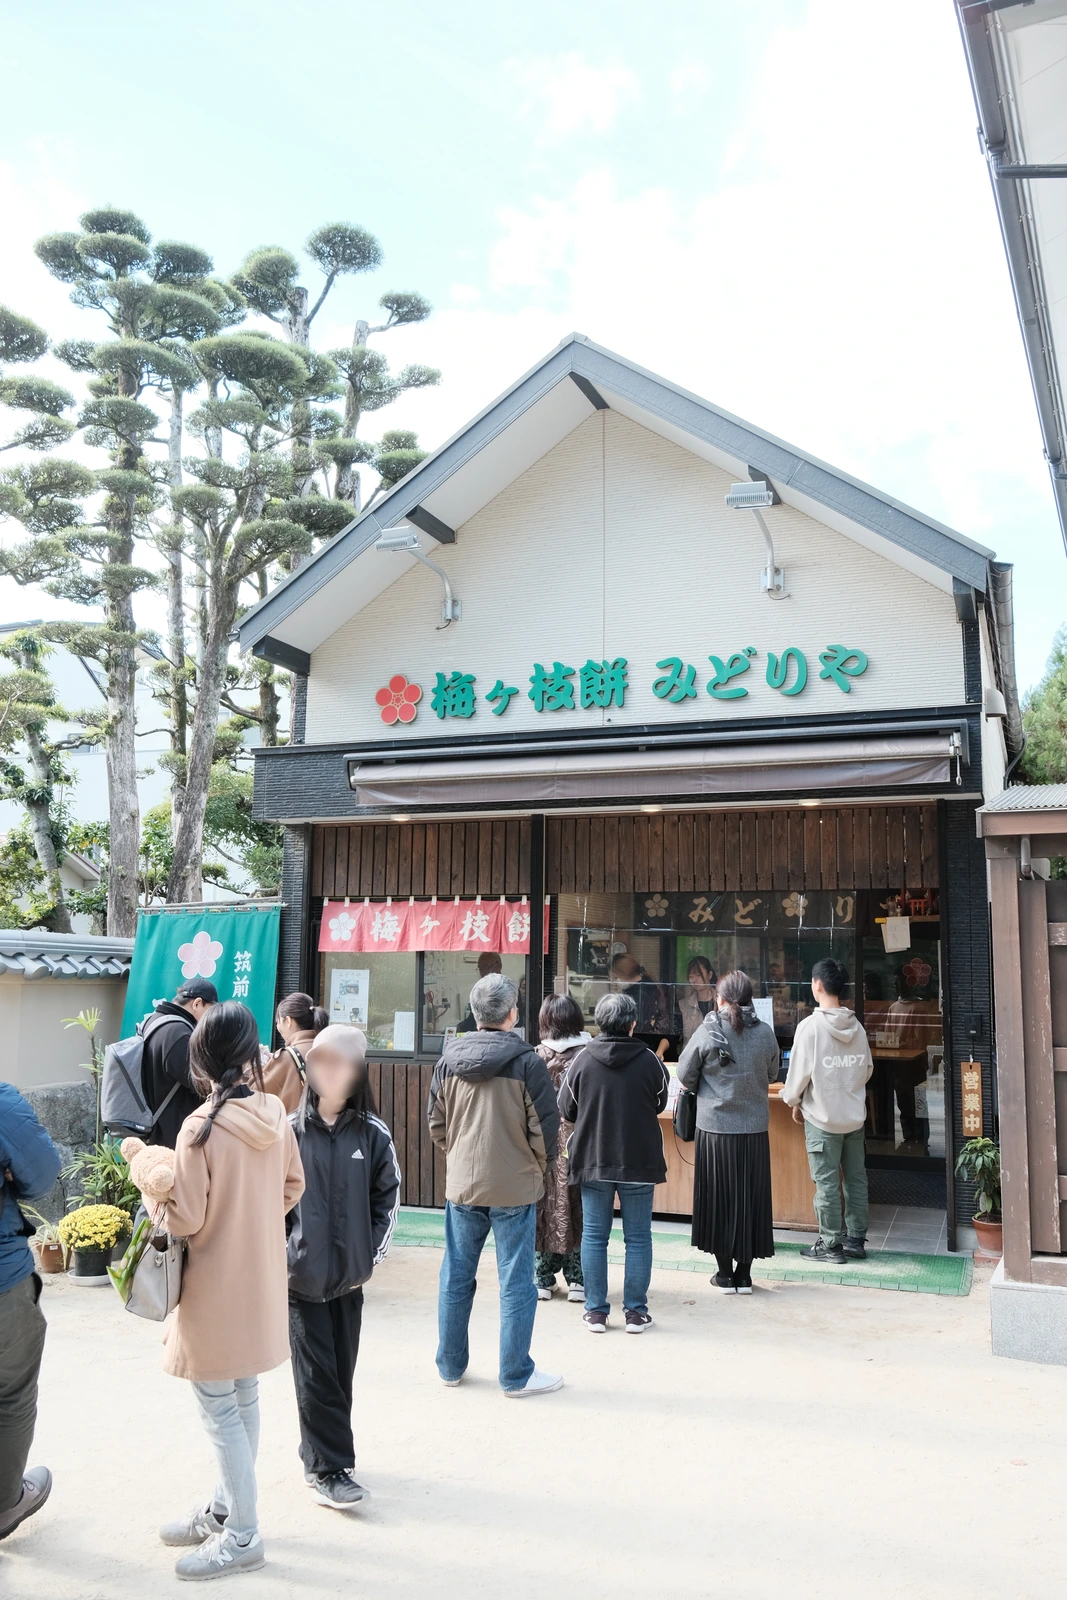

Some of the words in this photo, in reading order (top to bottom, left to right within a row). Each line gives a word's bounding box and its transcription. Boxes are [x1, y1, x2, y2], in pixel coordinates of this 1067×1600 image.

[652, 644, 869, 703] みどりや
[688, 896, 888, 926] みどり
[232, 950, 252, 1004] 筑前
[963, 1071, 981, 1132] 営業中
